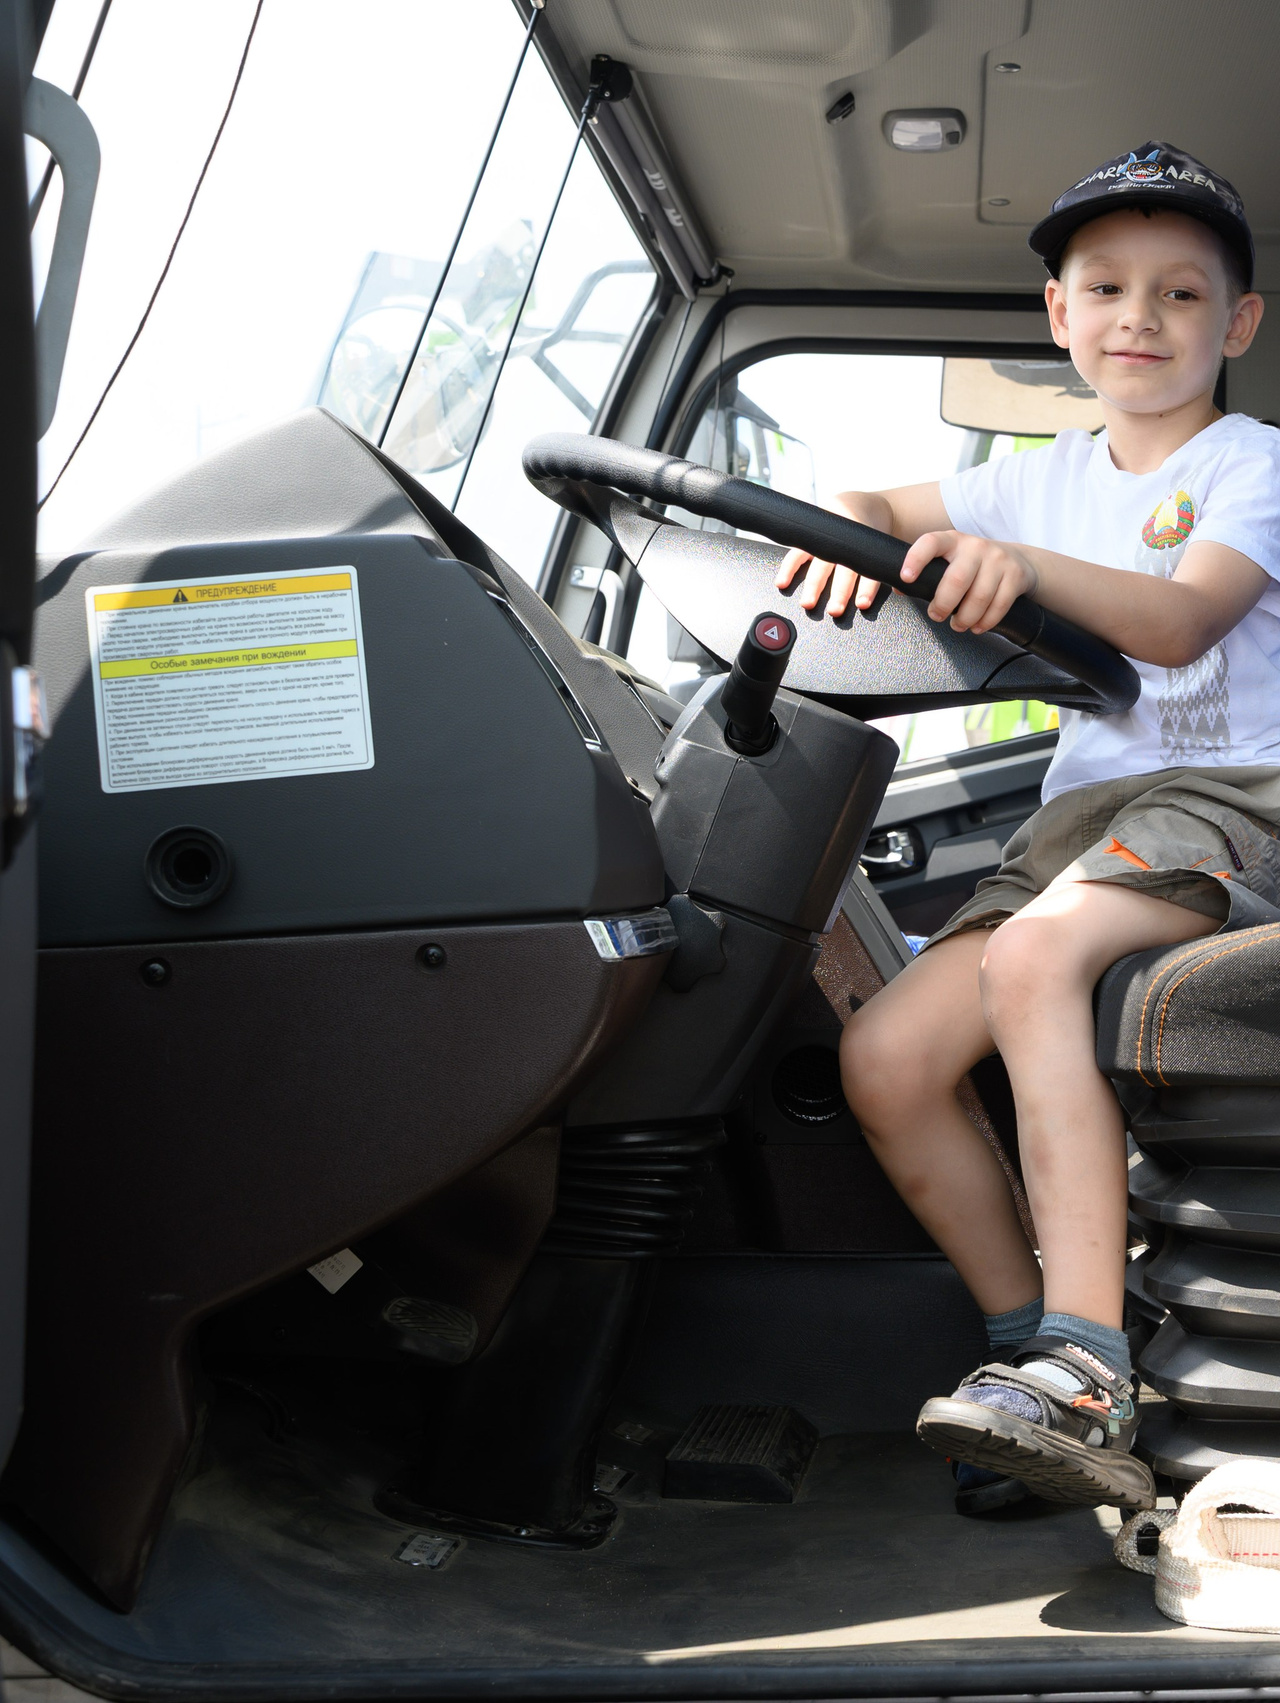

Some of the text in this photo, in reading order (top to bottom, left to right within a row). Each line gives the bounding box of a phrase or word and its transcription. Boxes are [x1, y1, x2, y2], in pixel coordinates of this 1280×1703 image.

[1165, 165, 1217, 193] AREA
[195, 582, 277, 598] ПРЕДУПРЕЖДЕНИЕ
[150, 648, 306, 669] Особые замечания при вождении
